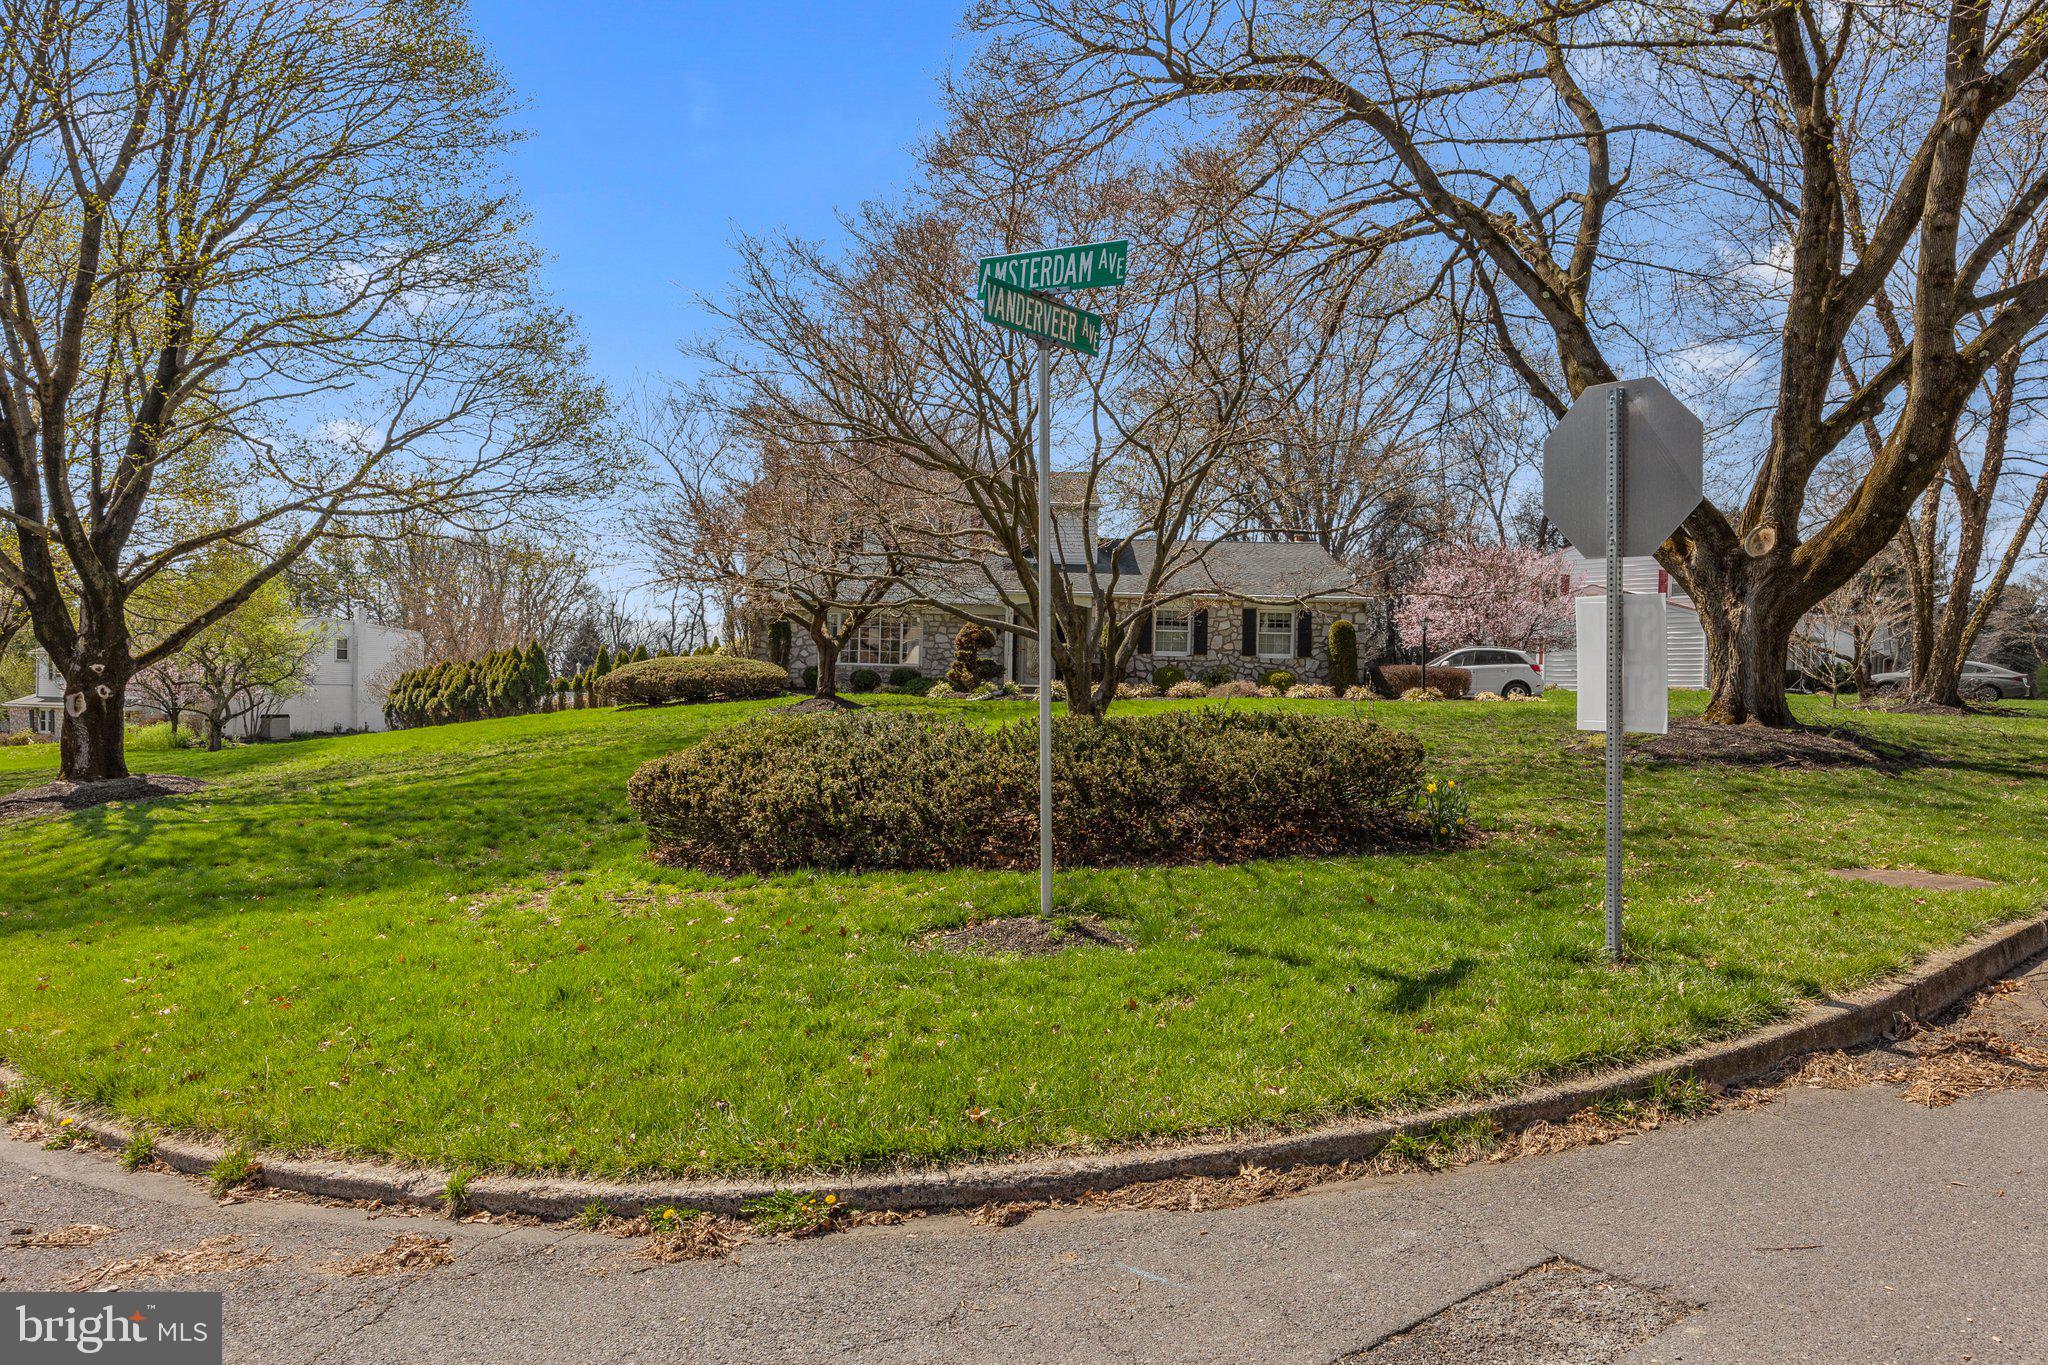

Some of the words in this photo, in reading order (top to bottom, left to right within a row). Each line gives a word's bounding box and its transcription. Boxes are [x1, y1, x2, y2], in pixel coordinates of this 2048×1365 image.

[980, 251, 1094, 294] AMSTERDAM
[1098, 248, 1125, 280] AVE
[987, 282, 1077, 344] VANDERVEER
[1082, 317, 1100, 352] AVE
